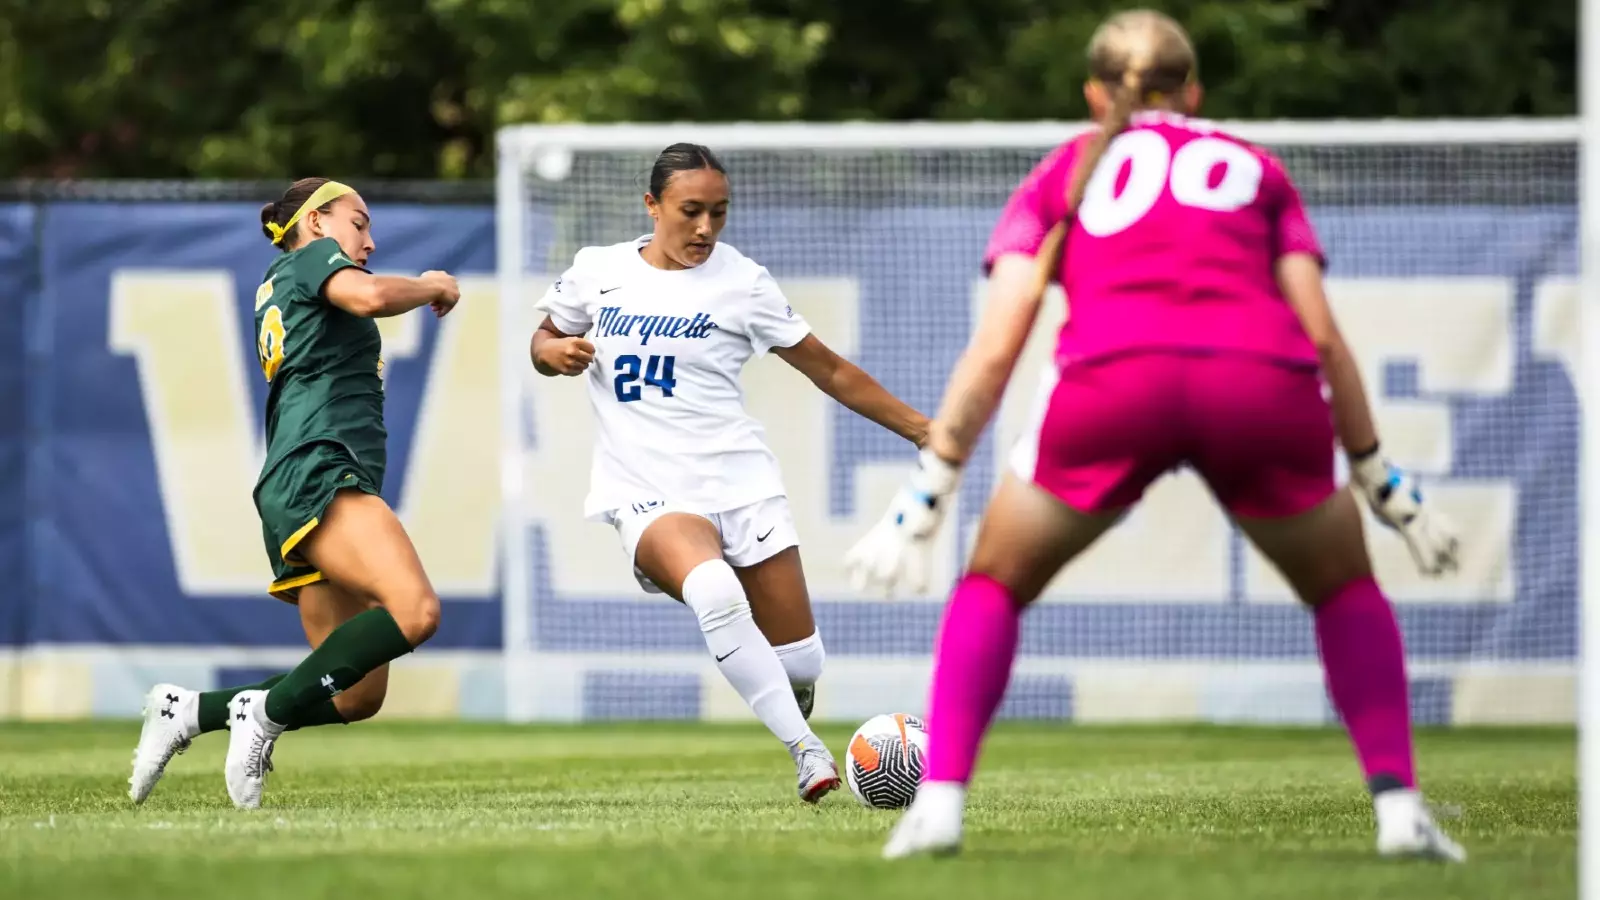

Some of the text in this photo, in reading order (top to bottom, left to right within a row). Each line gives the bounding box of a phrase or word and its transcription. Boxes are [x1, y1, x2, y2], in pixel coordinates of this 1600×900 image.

[1077, 128, 1263, 238] 00
[596, 306, 719, 345] Marquette
[614, 354, 676, 402] 24
